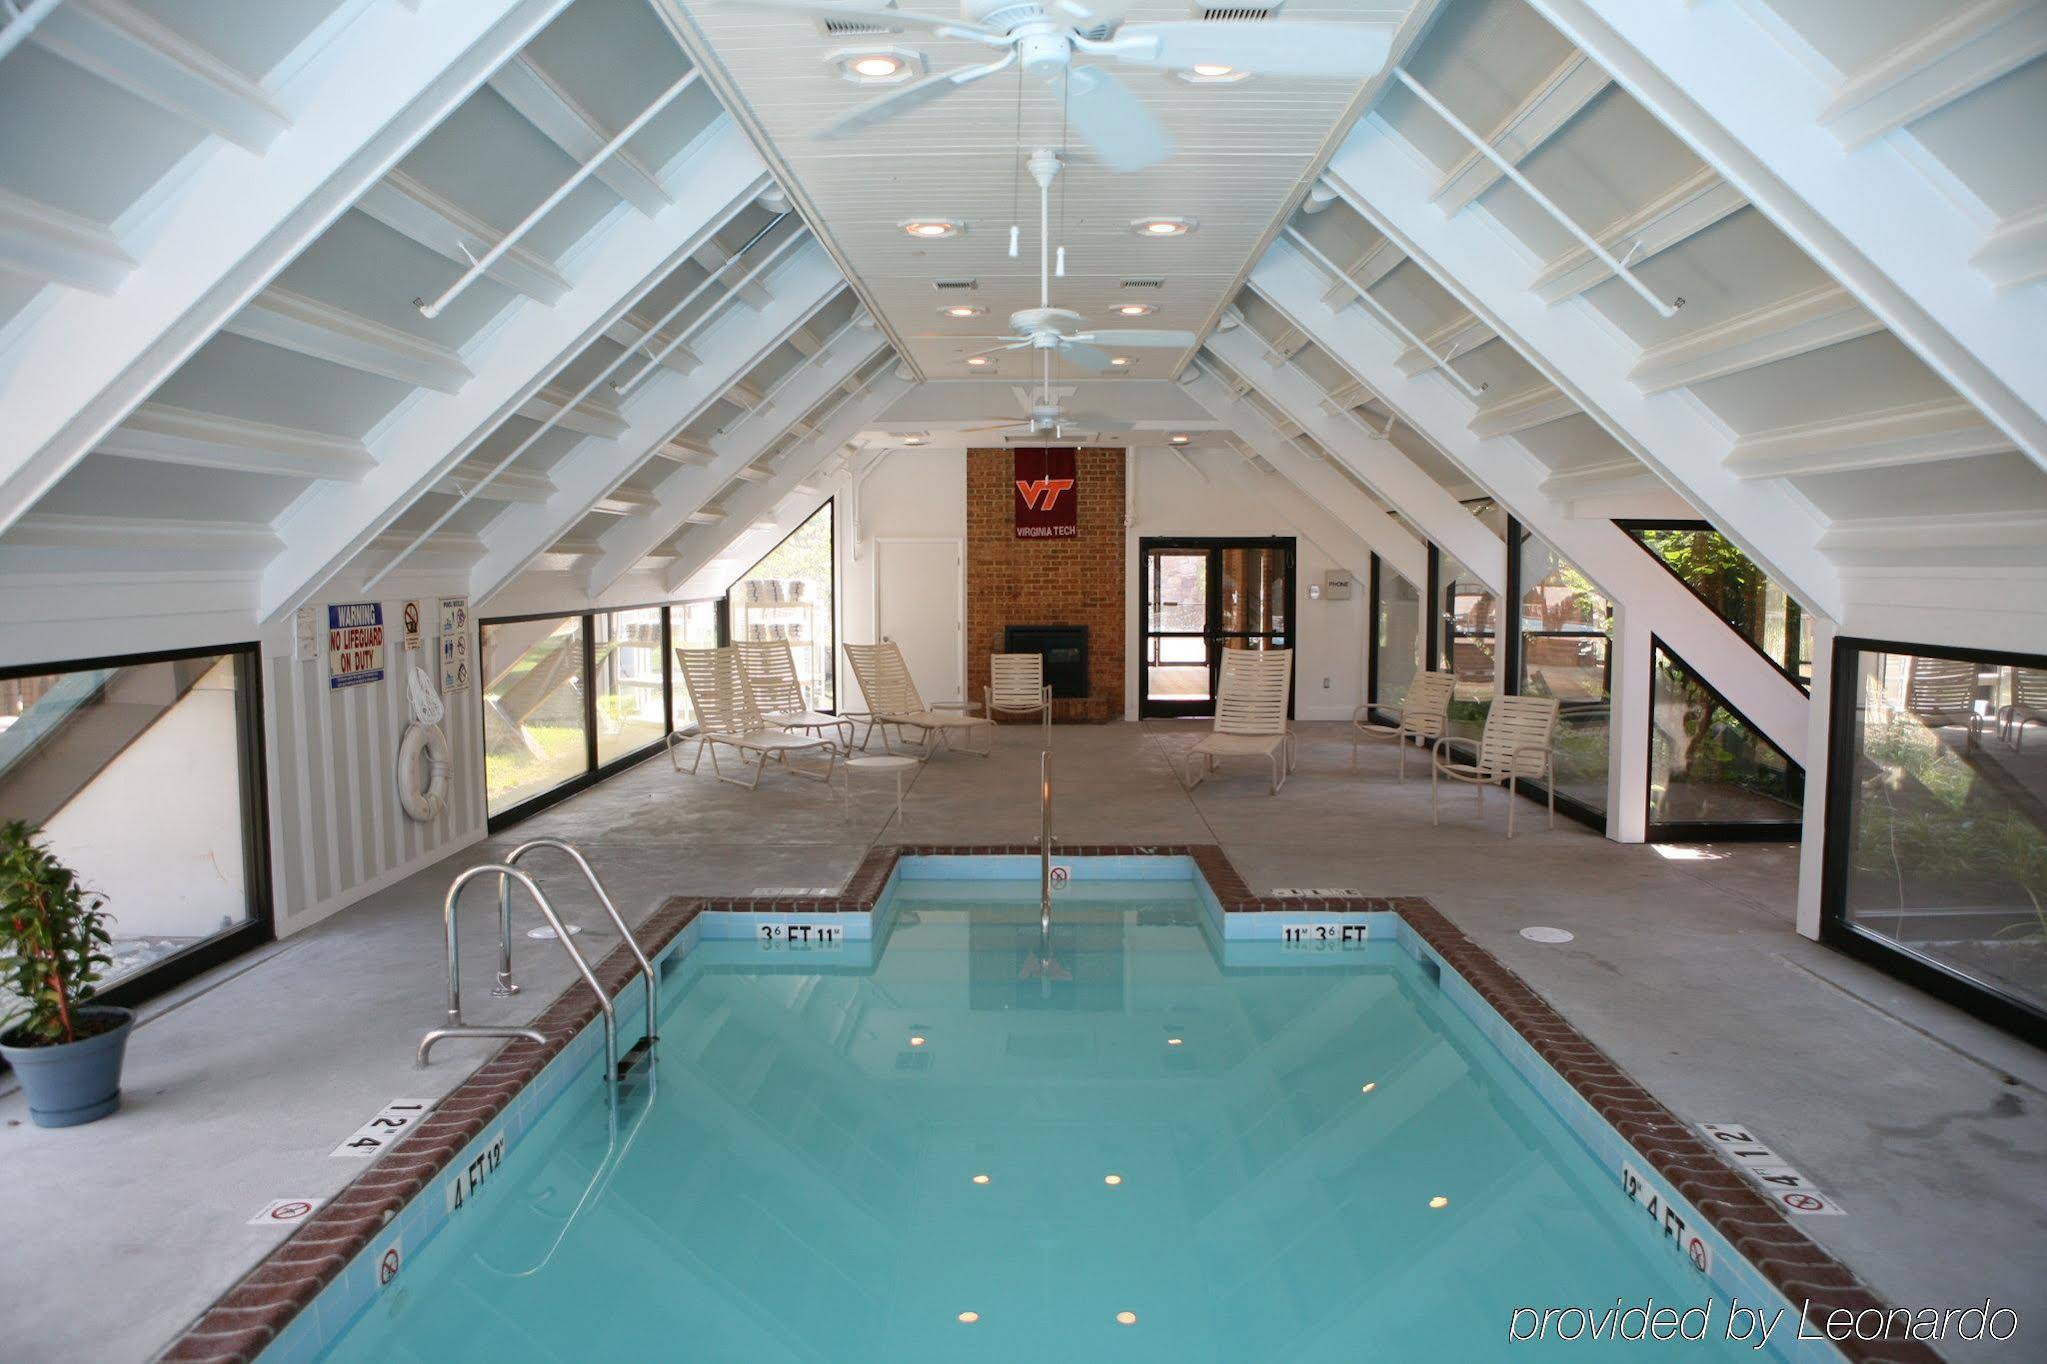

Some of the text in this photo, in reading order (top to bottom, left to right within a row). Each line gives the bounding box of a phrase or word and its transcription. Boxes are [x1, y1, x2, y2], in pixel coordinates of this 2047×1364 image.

[1016, 479, 1074, 511] VT
[1017, 526, 1076, 537] VIRGINIA TECH
[338, 604, 376, 627] WARNING
[331, 631, 341, 651] NO
[344, 627, 383, 649] LIFEGUARD
[341, 650, 374, 672] ON DUTY
[788, 926, 811, 942] FT
[1342, 926, 1366, 942] FT
[469, 1152, 485, 1197] FT
[1665, 1206, 1685, 1251] FT
